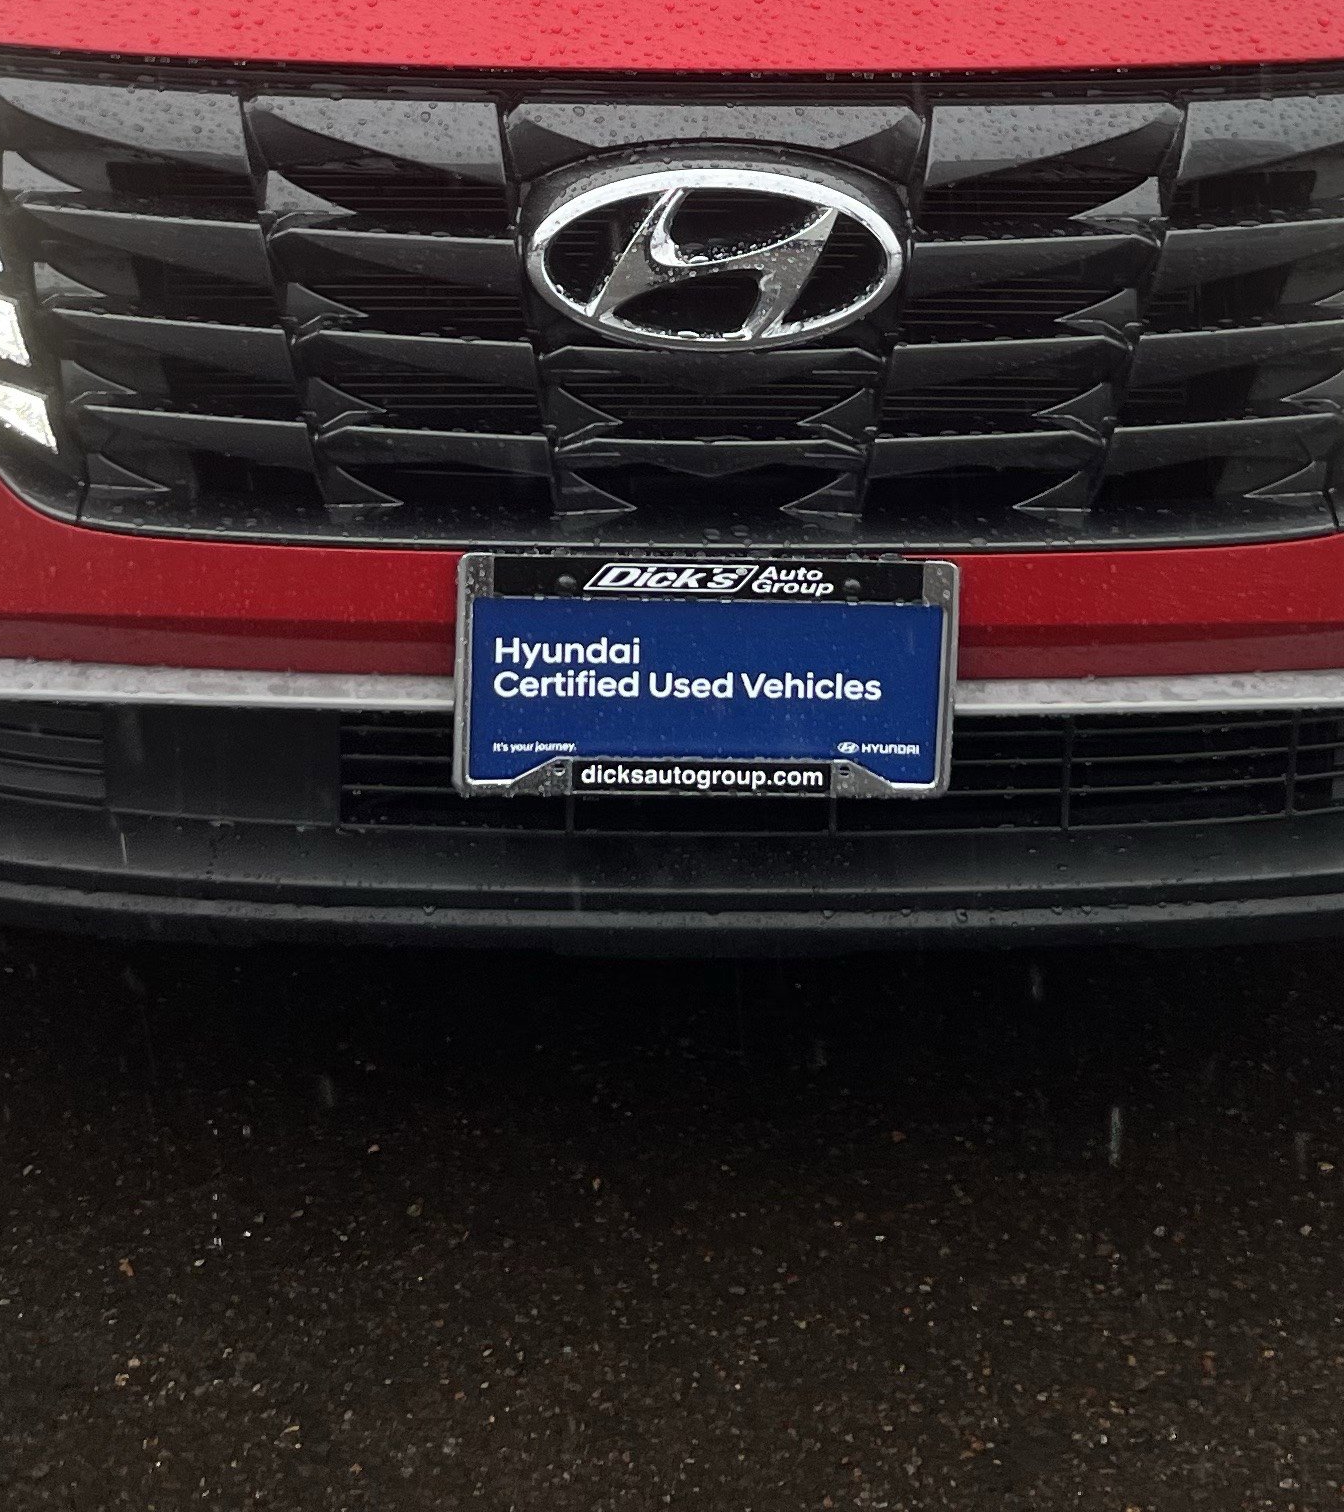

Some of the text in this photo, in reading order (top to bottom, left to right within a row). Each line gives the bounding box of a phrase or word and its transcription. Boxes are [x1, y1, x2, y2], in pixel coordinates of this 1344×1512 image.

[597, 566, 740, 589] Dick's
[758, 565, 824, 581] Auto
[751, 579, 835, 597] Group
[494, 637, 641, 670] Hyundai
[492, 669, 883, 702] Certified Used Vehicles
[492, 742, 509, 752] It's
[510, 743, 534, 754] your
[861, 743, 920, 755] HYUNDAI
[580, 764, 824, 790] dicksautogroup.com
